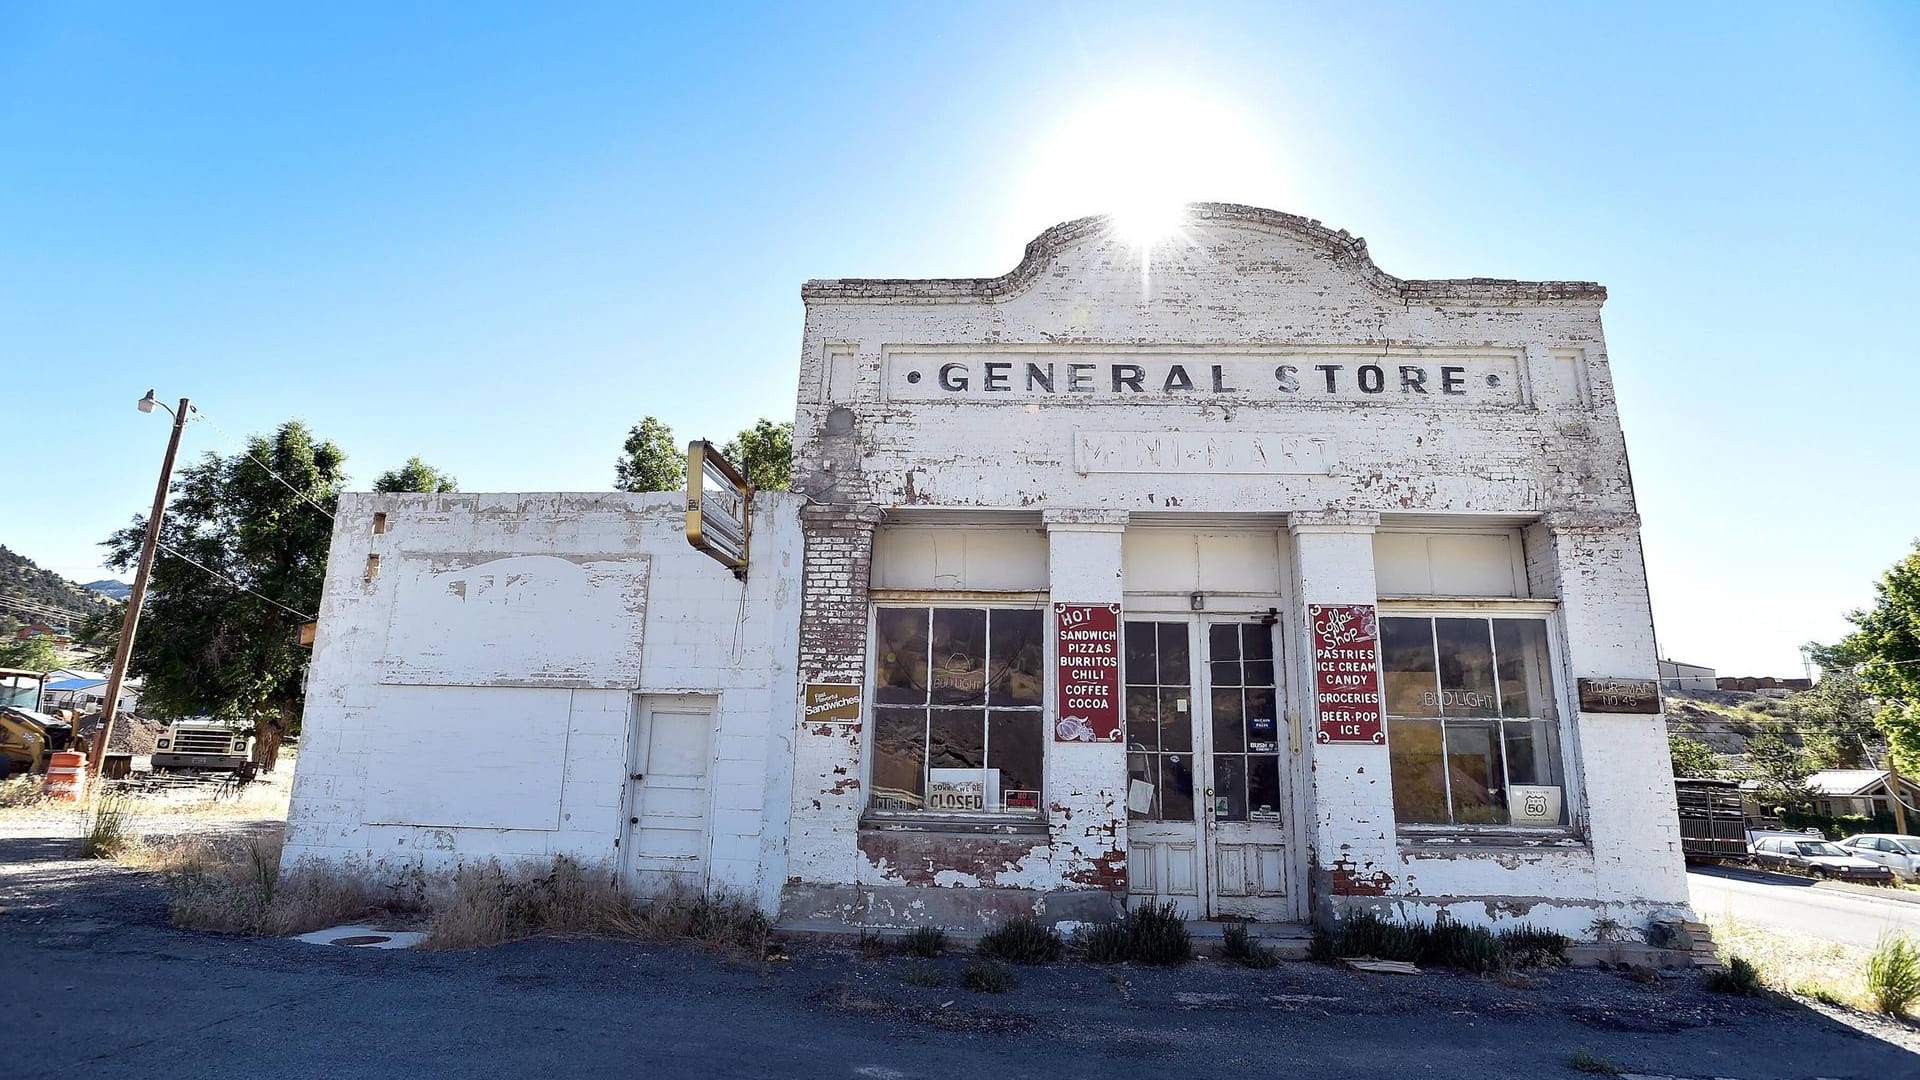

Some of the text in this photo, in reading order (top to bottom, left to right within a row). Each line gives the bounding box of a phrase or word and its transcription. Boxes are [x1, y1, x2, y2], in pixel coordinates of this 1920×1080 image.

[938, 362, 1466, 395] GENERAL STORE
[1061, 608, 1092, 626] HOT
[1315, 609, 1354, 635] Coffee
[1060, 630, 1116, 640] SANDWICH
[1323, 628, 1358, 650] Shop
[1068, 643, 1111, 653] PIZZAS
[1317, 649, 1374, 659] PASTRIES
[1060, 657, 1117, 666] BURRITOS
[1317, 662, 1376, 672] ICE CREAM
[1072, 670, 1104, 679] CHILI
[1326, 675, 1367, 685] CANDY
[1065, 685, 1108, 695] COFFEE
[1588, 681, 1649, 694] TOUR MAP
[1068, 698, 1108, 708] COCOA
[1319, 693, 1378, 704] GROCERIES
[1455, 692, 1492, 709] LIGHT
[1622, 695, 1637, 707] 45
[806, 696, 860, 715] Sandwiches
[1321, 711, 1378, 722] BEER POP
[1340, 725, 1360, 734] ICE
[930, 793, 983, 810] CLOSED
[1528, 804, 1544, 813] 50
